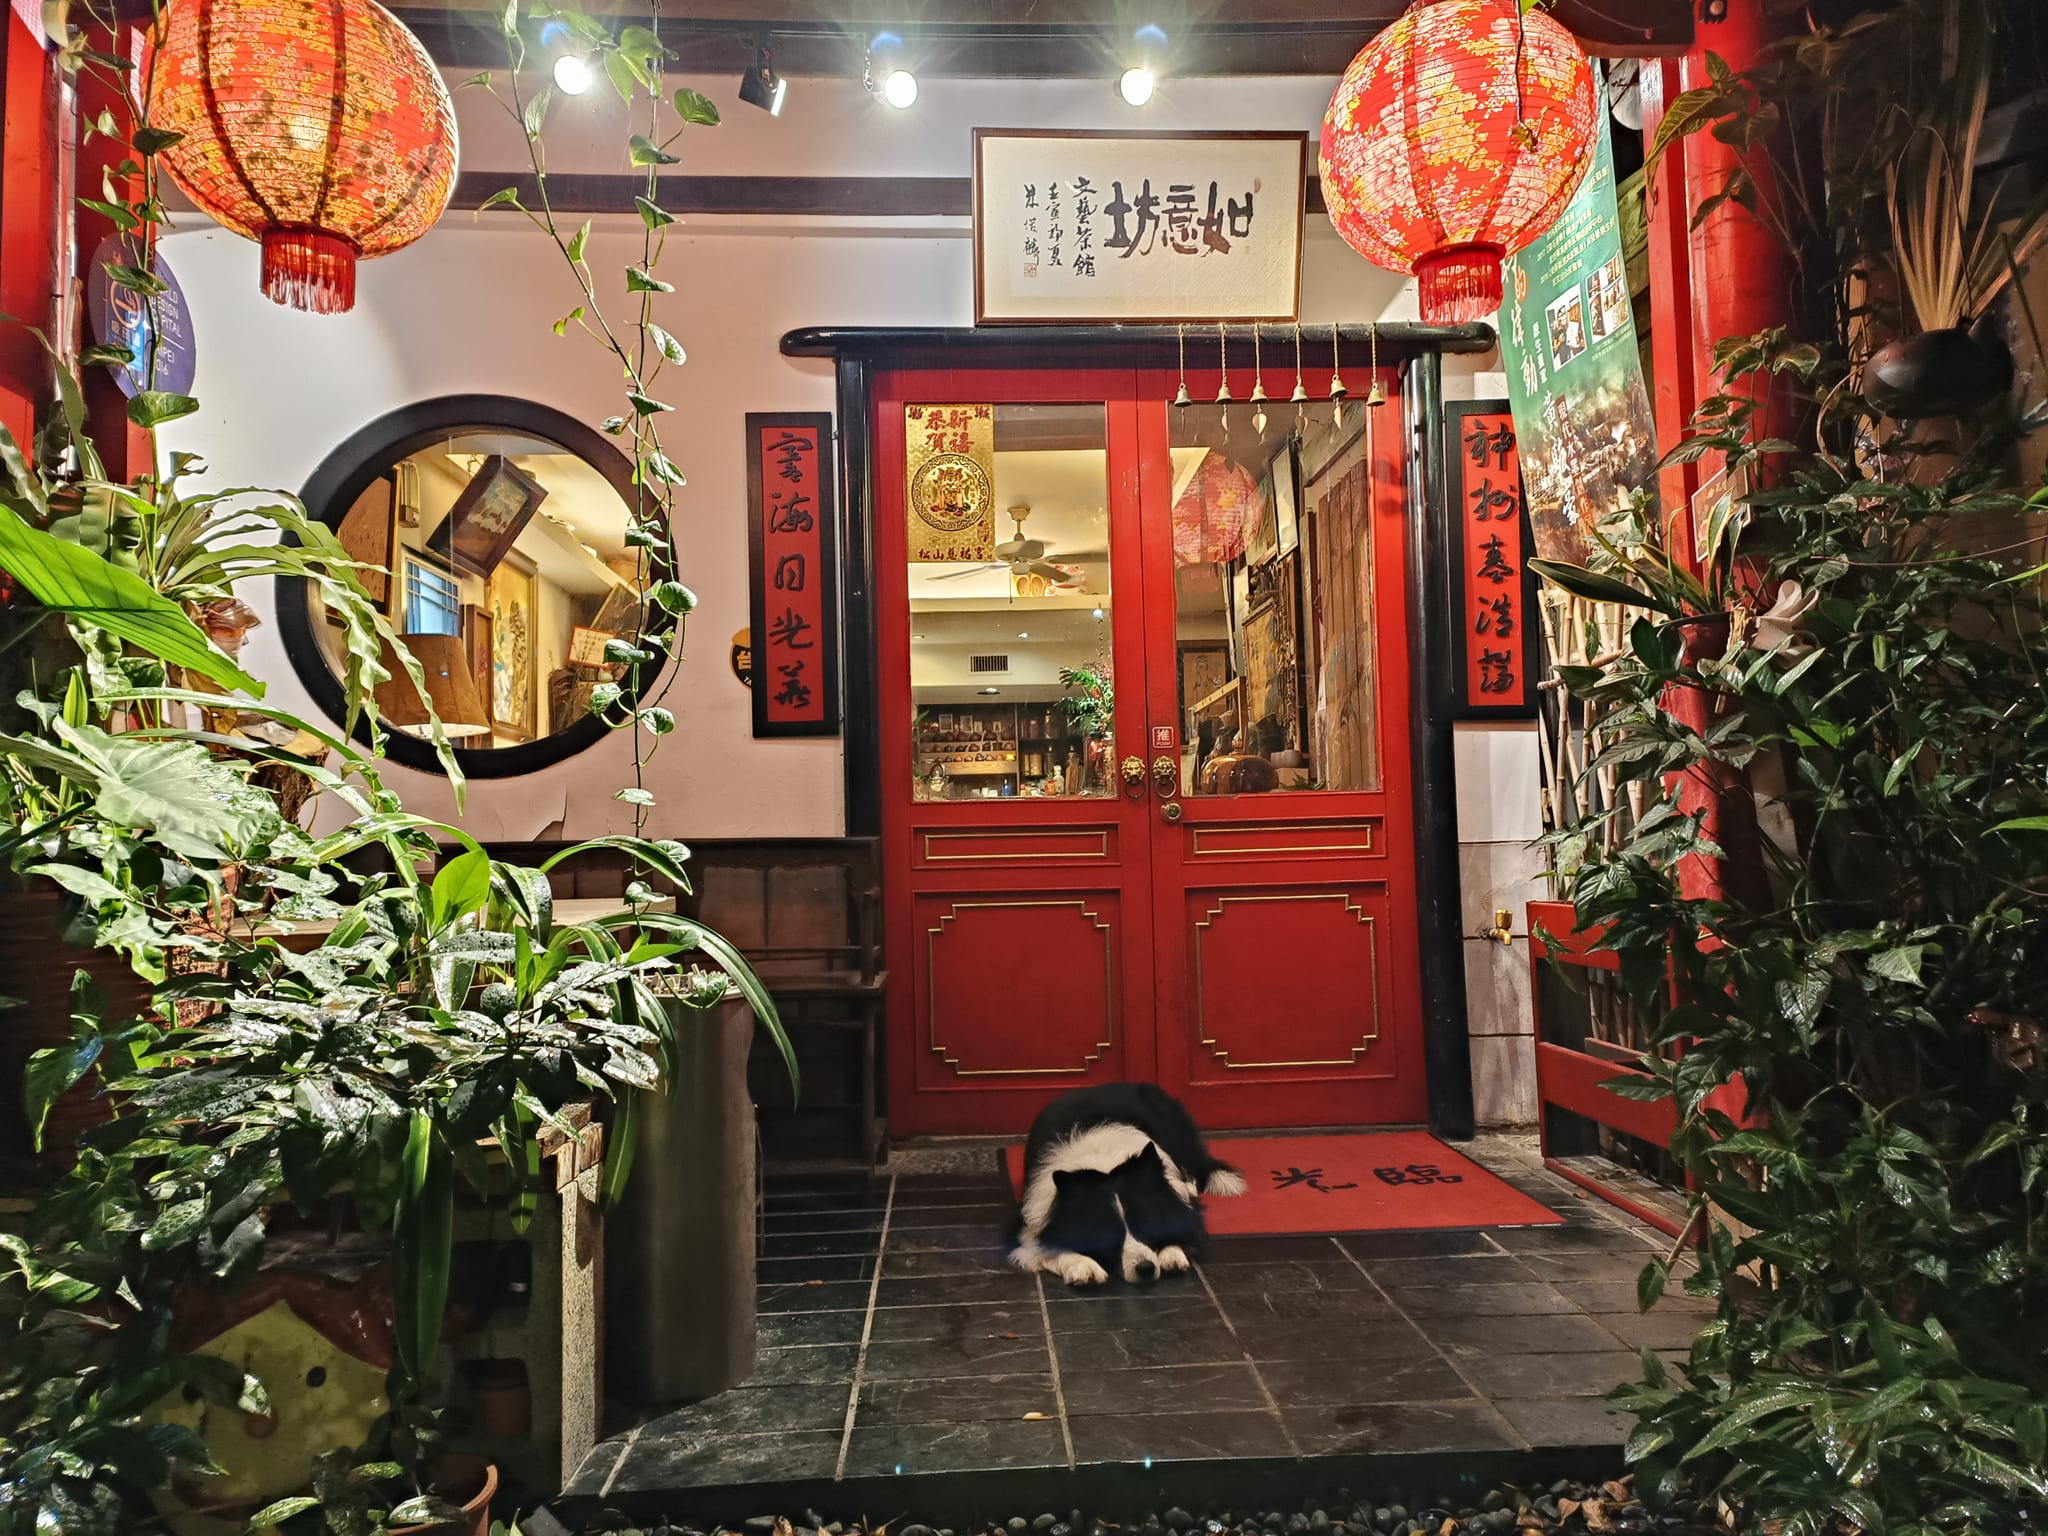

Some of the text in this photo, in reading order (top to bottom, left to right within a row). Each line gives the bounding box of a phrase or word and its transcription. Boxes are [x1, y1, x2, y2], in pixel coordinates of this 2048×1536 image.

[1072, 176, 1097, 277] 文藝茶館
[1271, 1164, 1464, 1193] 光臨
